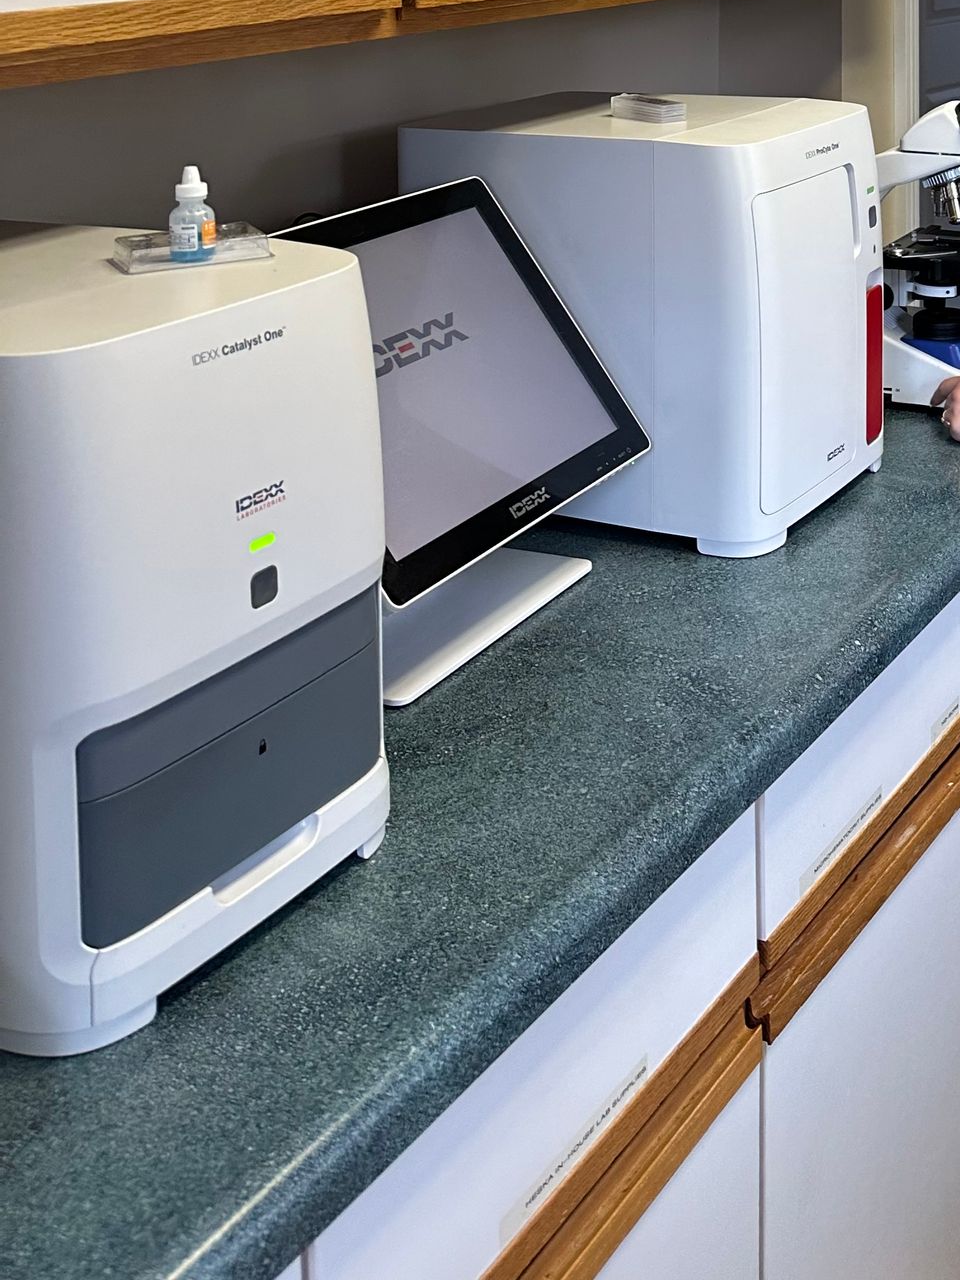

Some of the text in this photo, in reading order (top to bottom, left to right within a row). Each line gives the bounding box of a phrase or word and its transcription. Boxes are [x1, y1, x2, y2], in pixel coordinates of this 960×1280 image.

[191, 347, 220, 367] IDEXX
[221, 334, 262, 356] Catalyst
[372, 311, 470, 379] DEXX
[235, 479, 285, 514] IDEXX
[236, 494, 287, 522] LABORATORIES
[508, 486, 551, 520] IDEXX
[525, 1066, 647, 1209] HESKA IN-HOUSE LAB SUPPLIES
